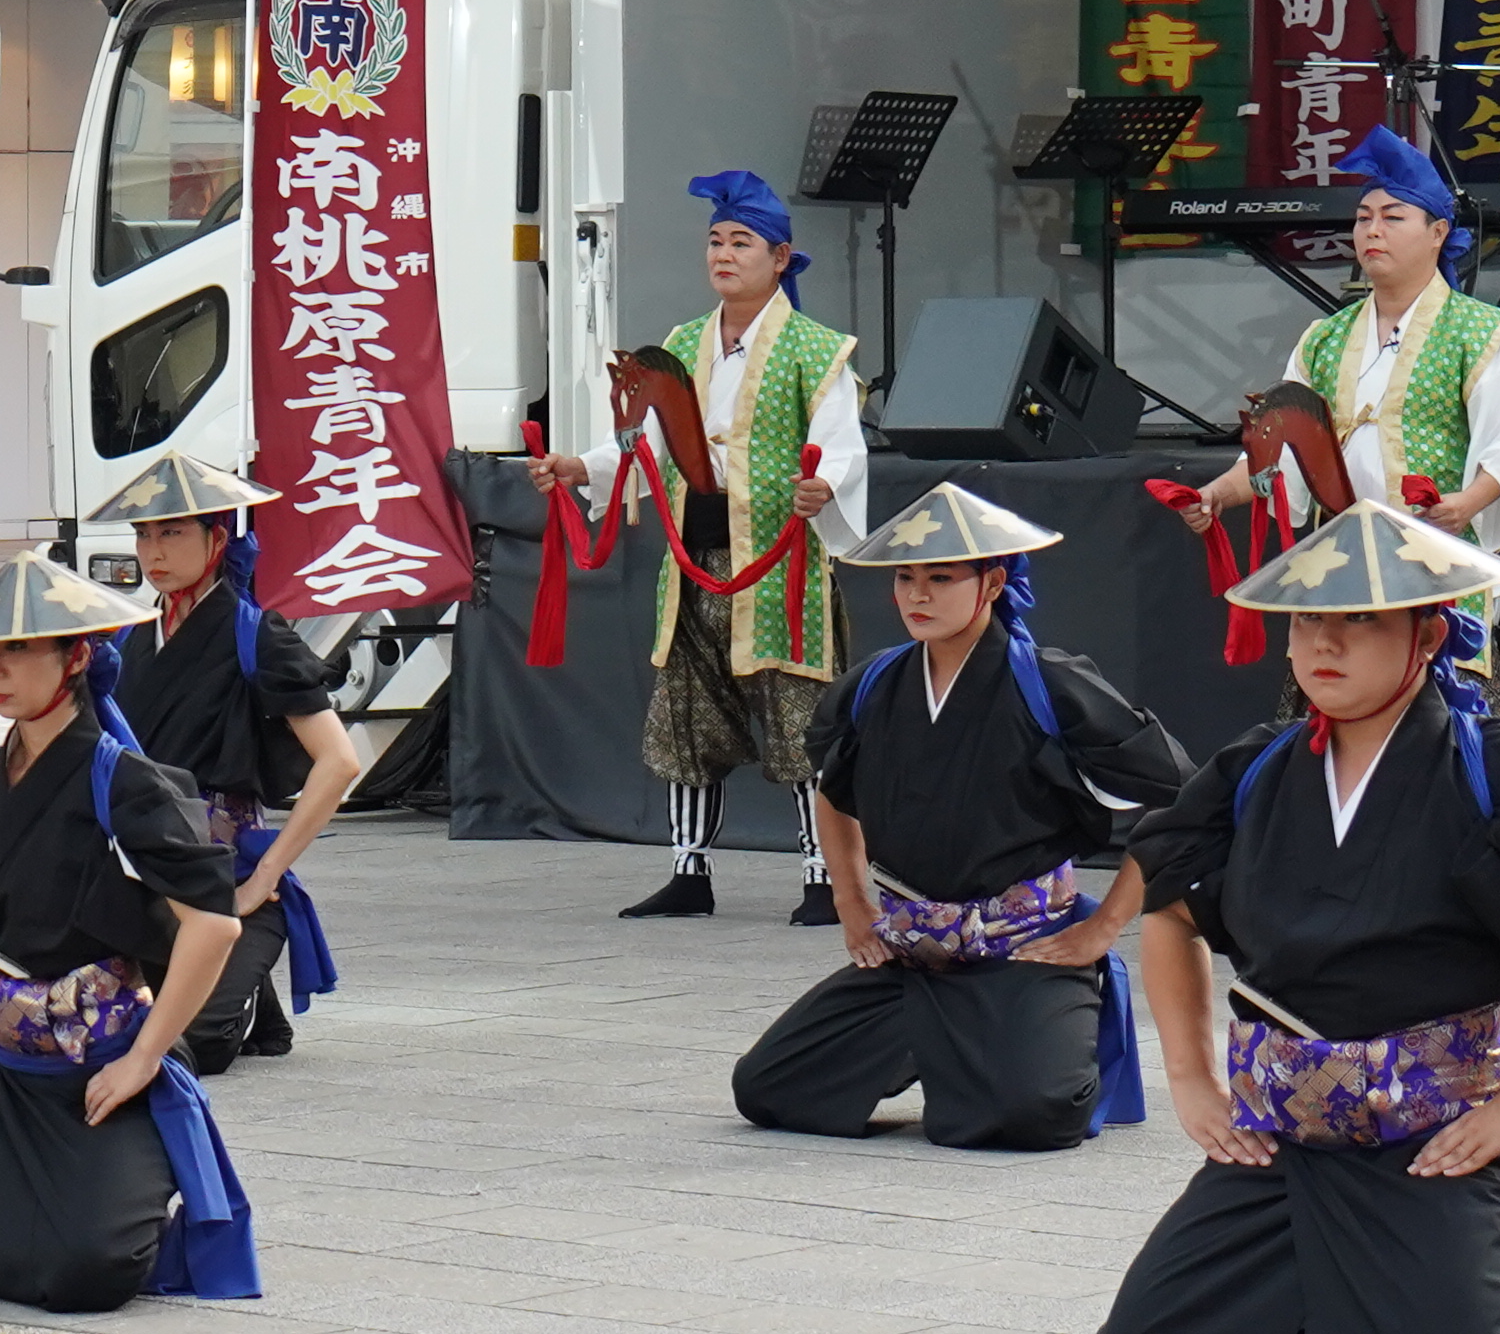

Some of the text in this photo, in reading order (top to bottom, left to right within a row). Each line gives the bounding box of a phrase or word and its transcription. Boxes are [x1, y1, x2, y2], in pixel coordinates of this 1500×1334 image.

[386, 137, 430, 276] 沖縄市
[1169, 200, 1227, 215] Roland
[271, 127, 443, 606] 南桃原青年会
